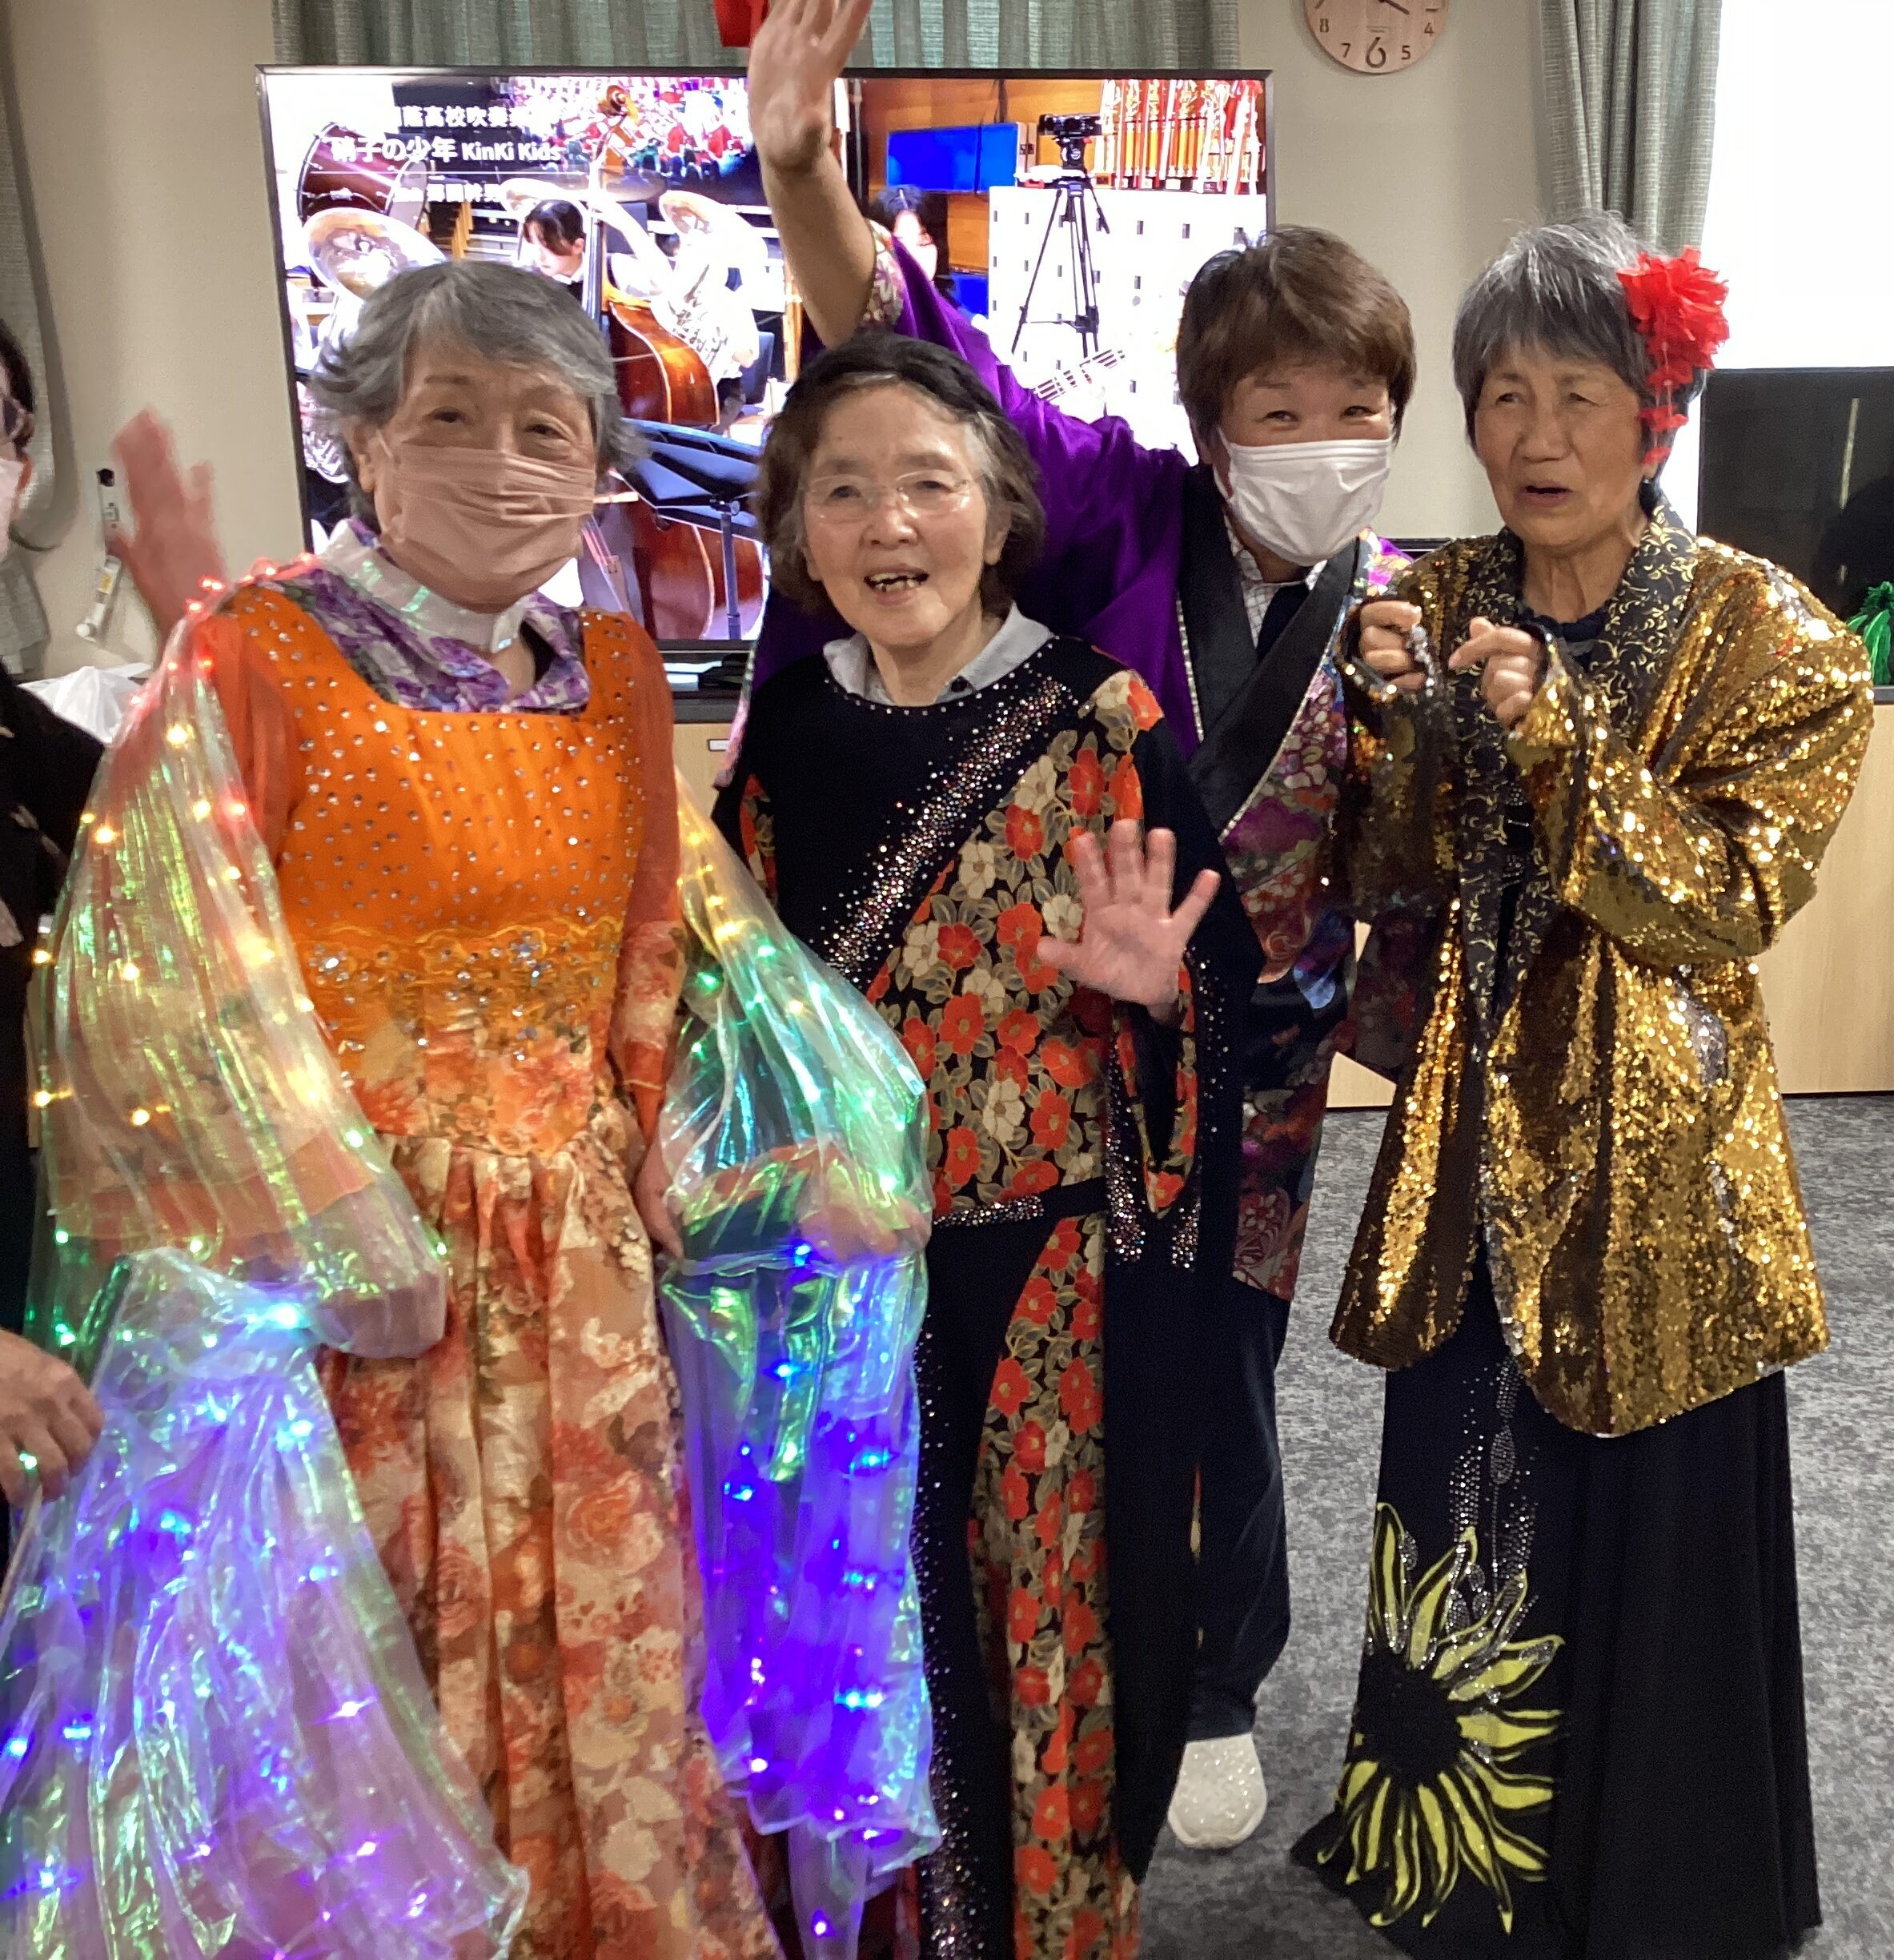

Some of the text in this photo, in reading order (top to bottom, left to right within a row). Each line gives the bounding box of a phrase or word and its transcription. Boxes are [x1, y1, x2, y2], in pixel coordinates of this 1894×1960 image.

[1319, 18, 1330, 33] 8
[1423, 22, 1435, 37] 4
[1340, 42, 1351, 58] 7
[1365, 36, 1386, 68] 6
[1401, 45, 1411, 60] 5
[461, 141, 515, 161] KinKi
[517, 141, 562, 161] Kids
